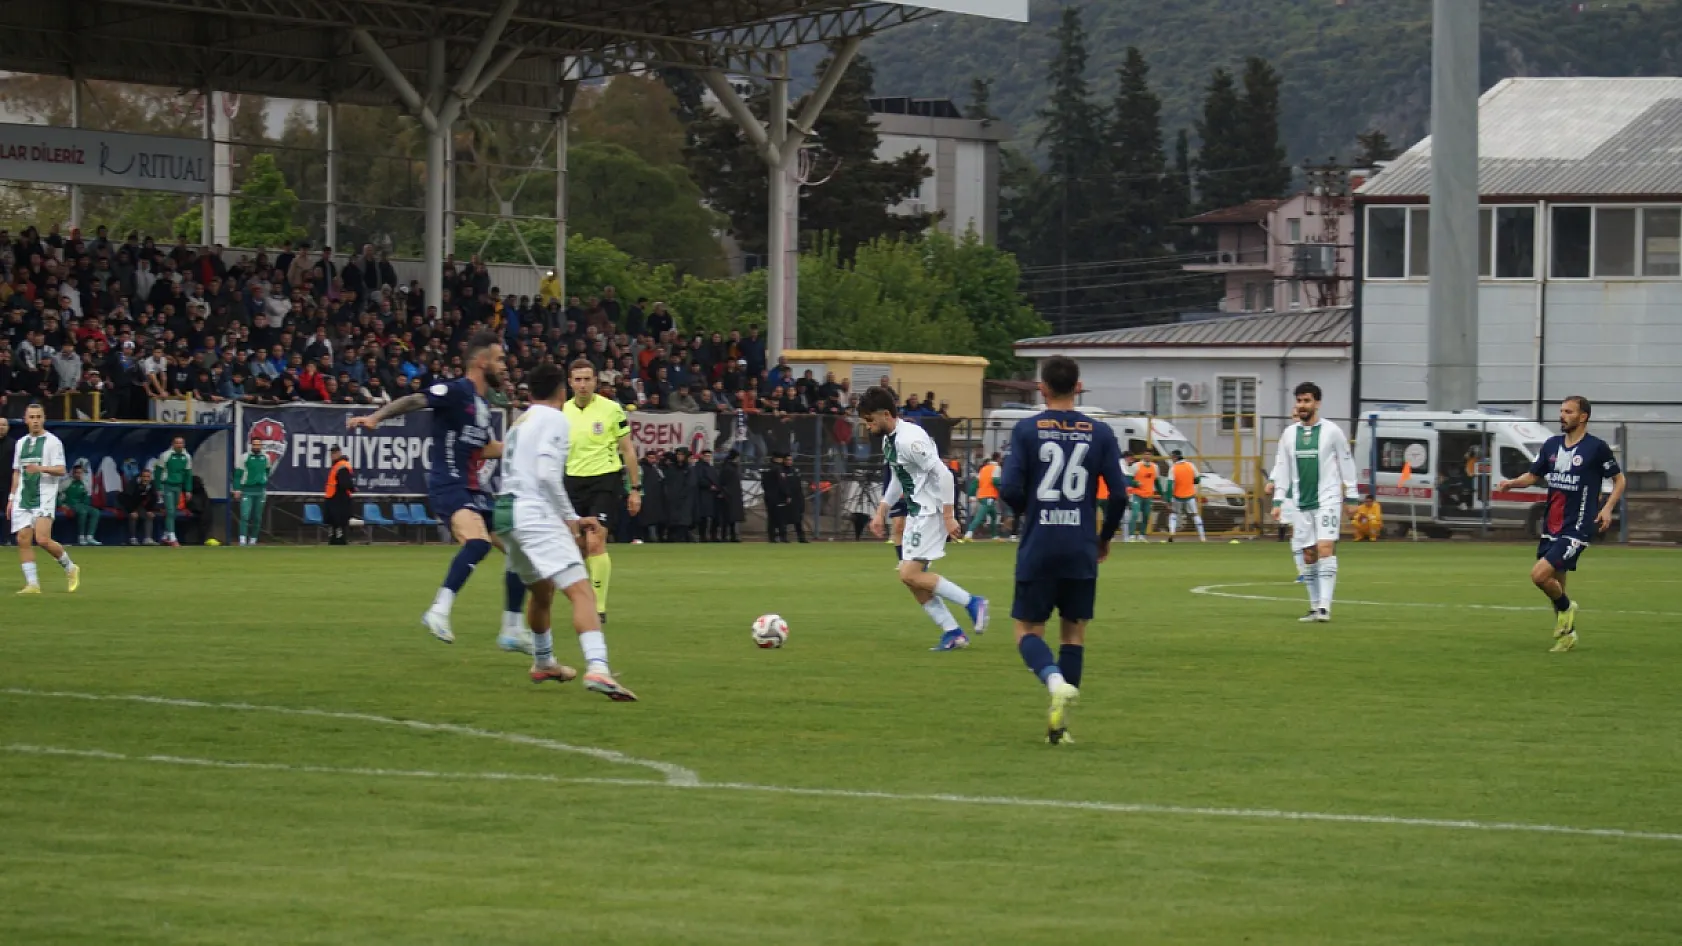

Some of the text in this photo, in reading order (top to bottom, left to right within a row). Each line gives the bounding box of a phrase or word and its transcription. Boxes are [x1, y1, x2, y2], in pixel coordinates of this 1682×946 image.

[32, 141, 85, 165] DİLERİZ
[1037, 430, 1093, 442] BETON
[1036, 441, 1090, 502] 26
[1321, 515, 1338, 528] 80
